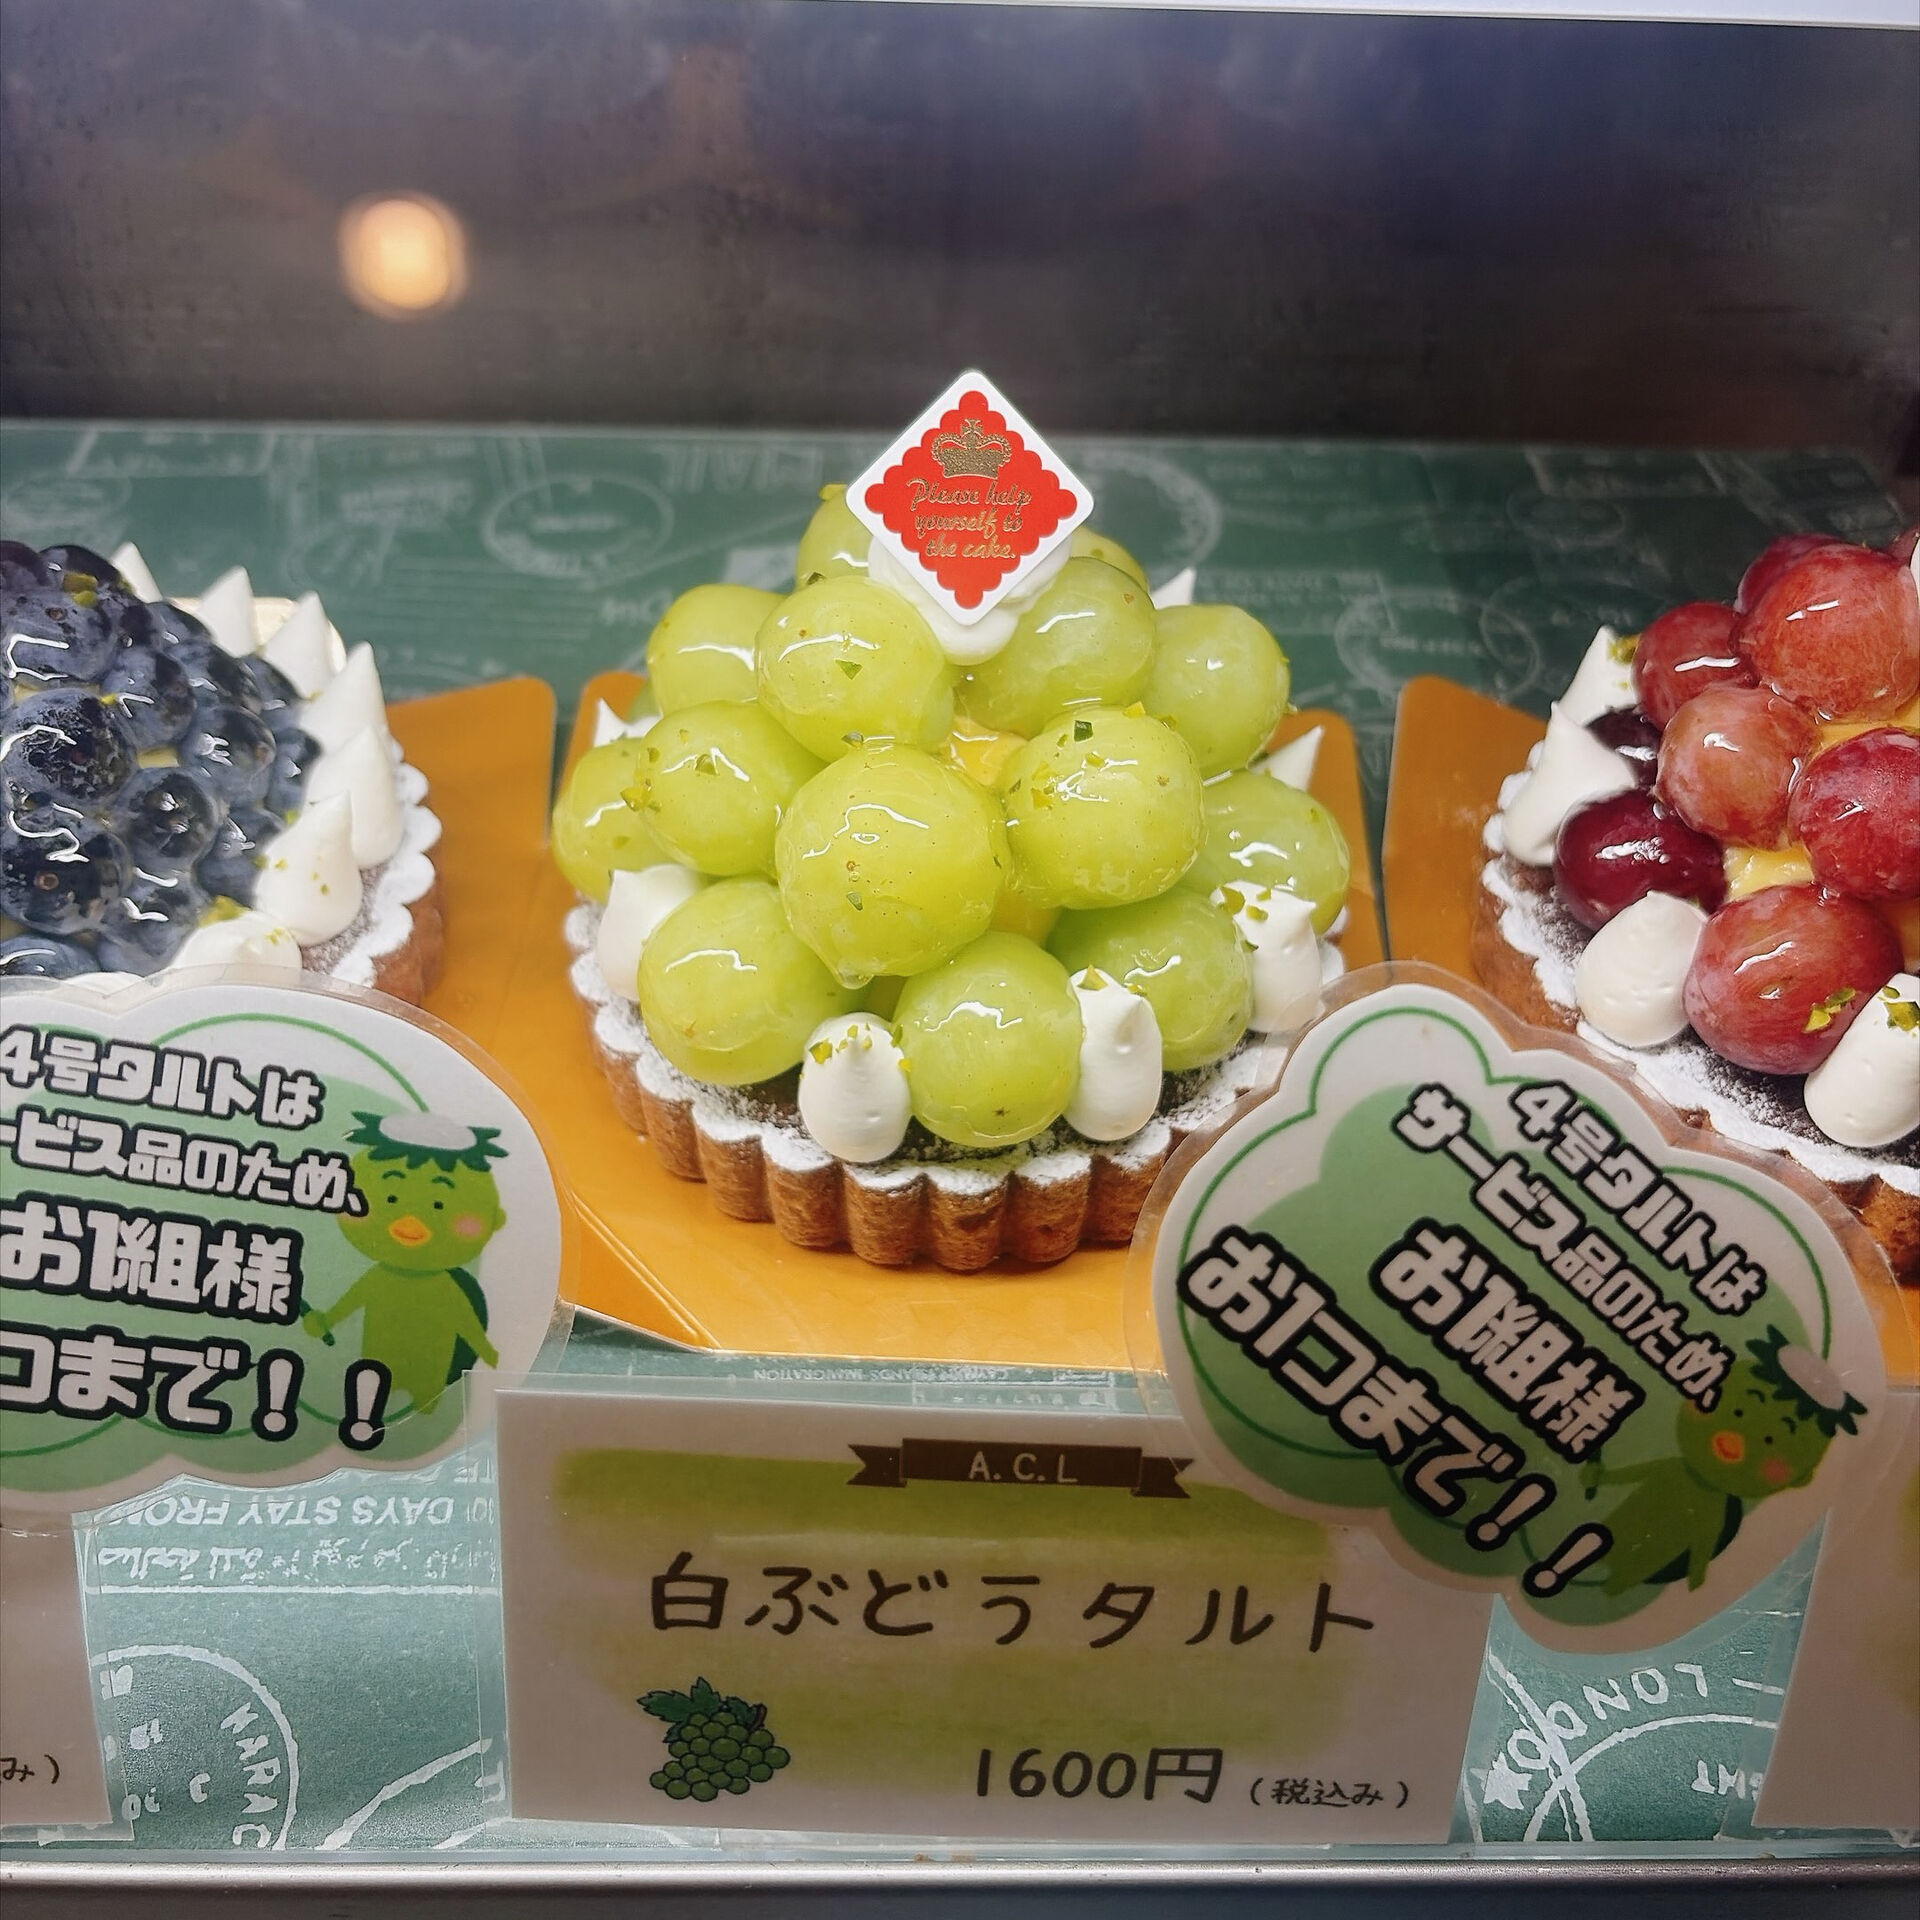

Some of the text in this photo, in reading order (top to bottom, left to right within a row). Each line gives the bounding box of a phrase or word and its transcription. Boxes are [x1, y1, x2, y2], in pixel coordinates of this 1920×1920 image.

[905, 476, 1032, 514] Please help
[914, 503, 1023, 540] yourself to
[925, 531, 1016, 560] the cake.
[0, 1027, 323, 1129] 4号タルトは
[1513, 1083, 1764, 1313] 4号タルトは
[1393, 1085, 1734, 1410] サービス品のため、
[237, 1496, 342, 1527] STAY
[351, 1496, 455, 1527] DAYS
[650, 1551, 1375, 1654] 白ぶどうタルト
[976, 1746, 1224, 1804] 1600円
